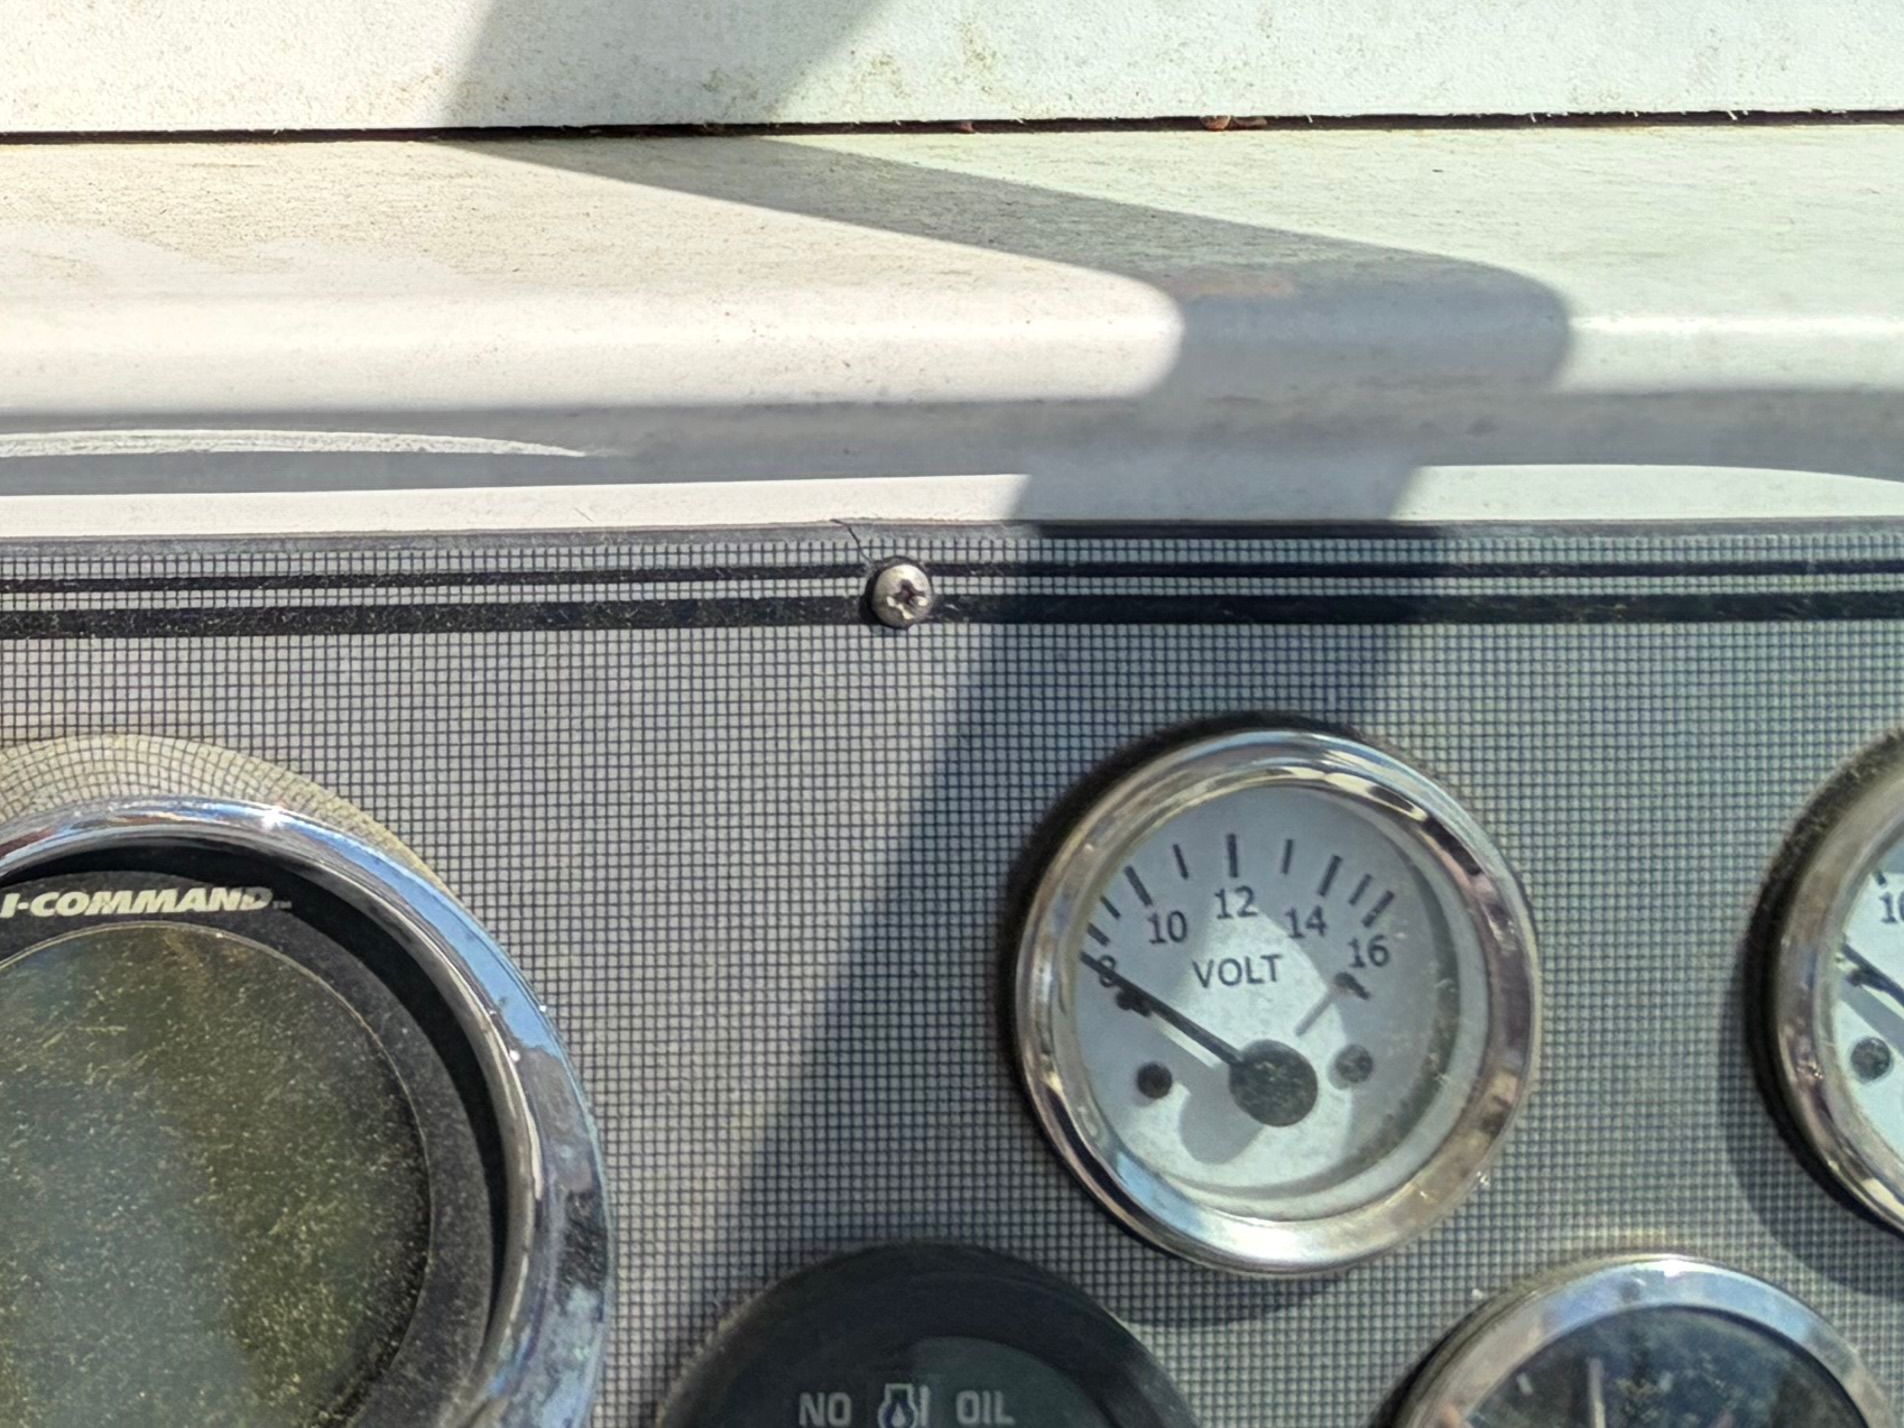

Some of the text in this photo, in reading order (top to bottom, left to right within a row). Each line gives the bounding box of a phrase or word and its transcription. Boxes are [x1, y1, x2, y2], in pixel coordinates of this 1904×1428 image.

[1214, 886, 1259, 919] 12
[1879, 890, 1904, 924] 1
[1147, 911, 1188, 944] 10
[1285, 906, 1329, 939] 14
[1348, 936, 1390, 969] 16
[1192, 954, 1284, 988] VOLT
[799, 1390, 1015, 1428] NO OIL
